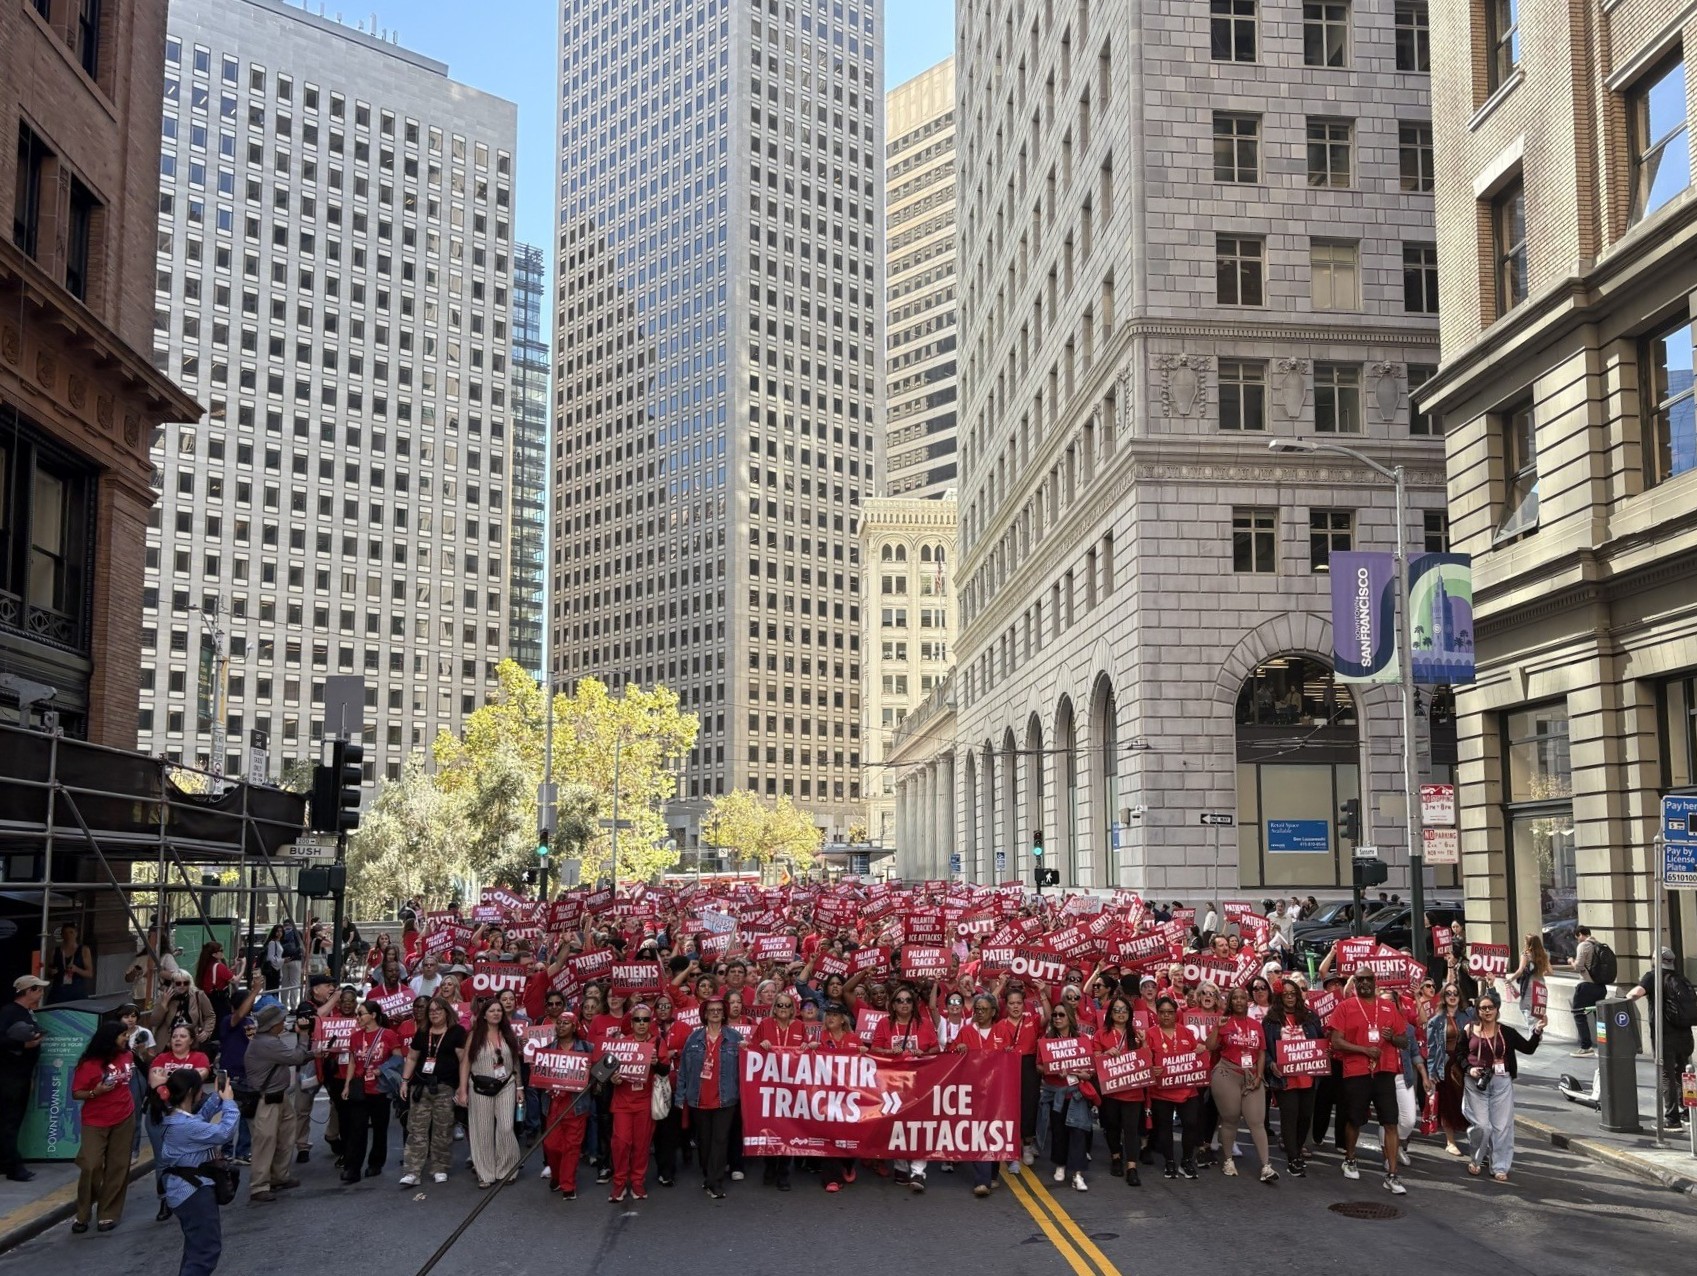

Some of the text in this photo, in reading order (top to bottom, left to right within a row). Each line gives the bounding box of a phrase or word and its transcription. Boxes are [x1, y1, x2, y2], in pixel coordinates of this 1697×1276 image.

[1666, 801, 1697, 812] Pay her
[1424, 830, 1434, 840] NO
[290, 847, 322, 856] BUSH
[1666, 847, 1693, 857] Pay by
[1667, 855, 1695, 863] License
[1000, 886, 1024, 895] OUT!
[494, 892, 522, 909] OUT!
[862, 896, 890, 914] PATIENTS
[958, 920, 994, 935] OUT!
[702, 933, 740, 949] PATIENS
[1049, 927, 1078, 946] PALANTIR
[1055, 937, 1078, 951] TRACKS
[1119, 934, 1165, 955] PATIENTS
[855, 948, 880, 959] PALANTIR
[908, 949, 940, 958] PALANTIR
[982, 949, 1015, 961] PATIEN
[1110, 954, 1119, 963] ICE
[822, 956, 848, 970] PALANTIR
[857, 958, 877, 969] TRACKS
[912, 958, 936, 966] TRACKS
[1012, 957, 1065, 980] OUT!
[1469, 954, 1508, 973] OUT!
[612, 965, 659, 978] PATIENTS
[814, 971, 824, 979] ICE
[906, 968, 947, 978] ICE ATTACKS!
[1184, 964, 1236, 987] OUT!
[473, 974, 526, 992] OUT!
[382, 1000, 403, 1010] TRACKS
[391, 1004, 414, 1017] ATTACKS
[677, 1008, 700, 1019] PALAN
[322, 1020, 357, 1029] PALANTIR
[325, 1028, 352, 1038] TRACKS
[860, 1032, 872, 1040] ICE
[601, 1042, 639, 1052] PALANTIR
[1046, 1039, 1078, 1051] PALANTIR
[1284, 1041, 1316, 1053] PALANTIR
[1051, 1049, 1077, 1059] TRACKS
[1103, 1052, 1137, 1068] PALANTIR
[1162, 1052, 1196, 1066] PALANTIR
[1288, 1050, 1313, 1062] TRACKS
[535, 1052, 589, 1071] PATIENTS
[1049, 1058, 1091, 1072] ICE ATTACKS!
[1283, 1059, 1326, 1073] ICE ATTACKS!
[745, 1051, 877, 1088] PALANTIR
[1109, 1063, 1135, 1077] TRACKS
[1167, 1062, 1193, 1075] TRACKS
[52, 1076, 61, 1087] SF
[1106, 1070, 1150, 1090] ICE ATTACKS!
[1162, 1071, 1206, 1086] ICE ATTACKS!
[759, 1085, 972, 1123] TRACKS ICE
[48, 1090, 61, 1152] DOWNTOWN
[888, 1120, 1014, 1152] ATTACKS!
